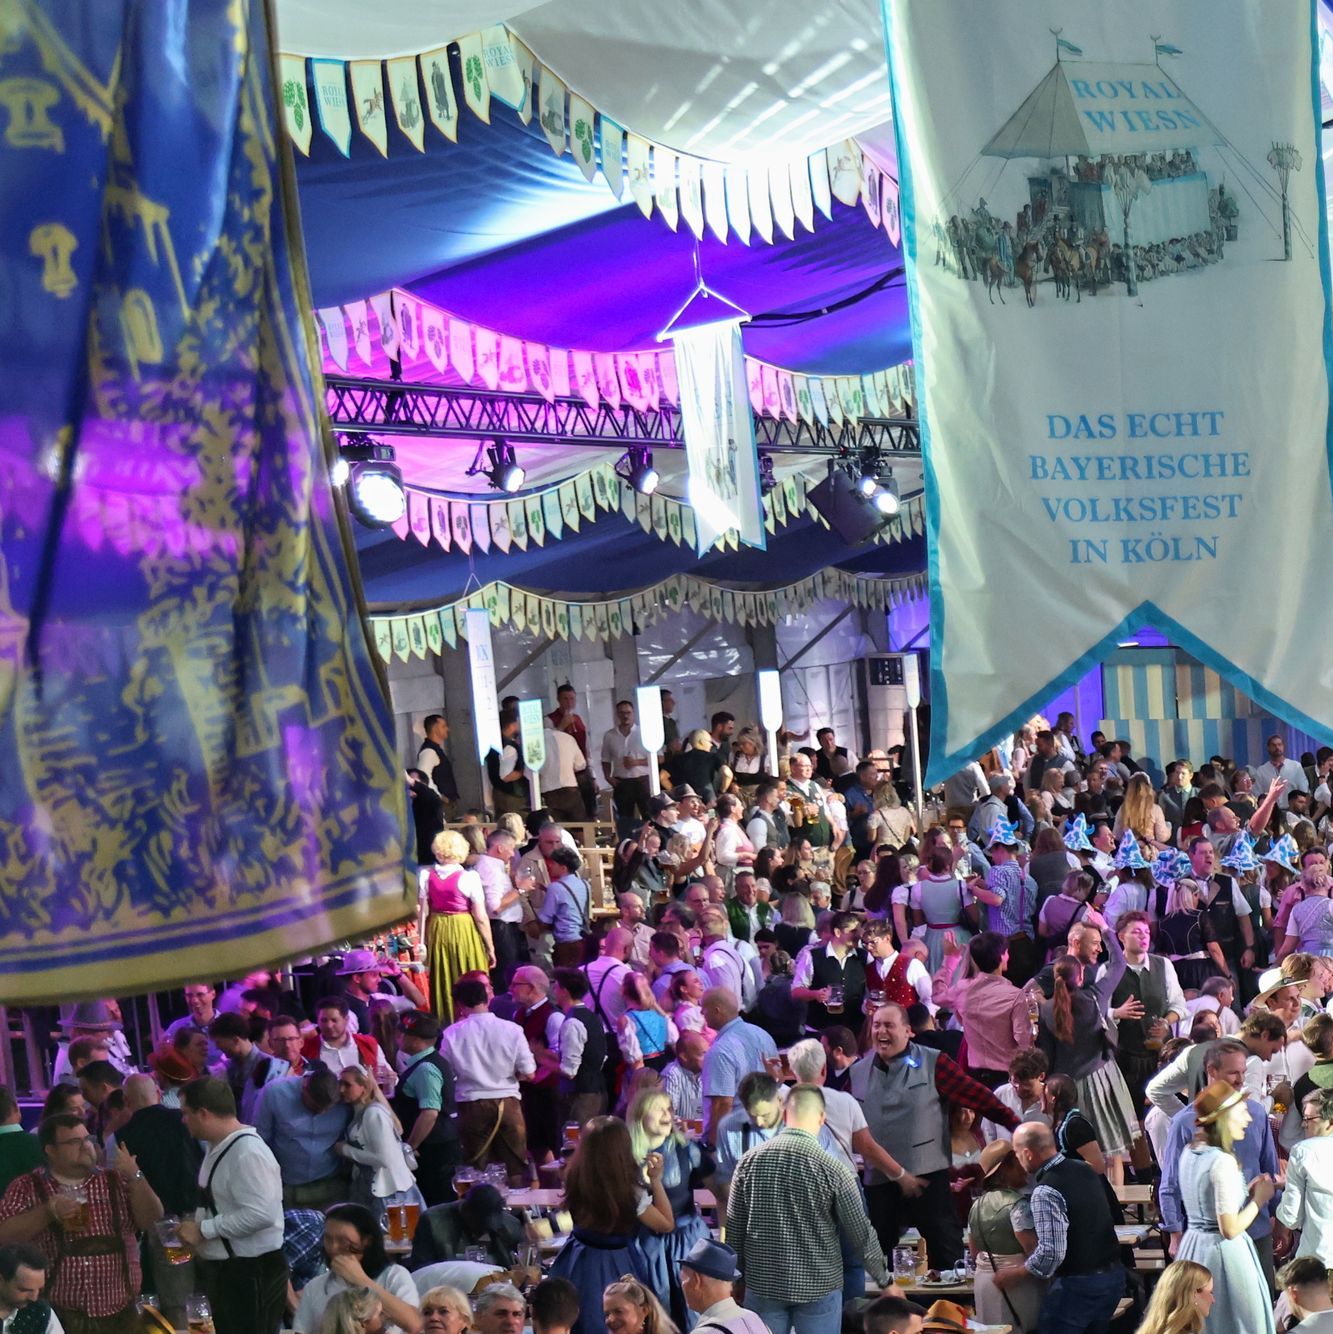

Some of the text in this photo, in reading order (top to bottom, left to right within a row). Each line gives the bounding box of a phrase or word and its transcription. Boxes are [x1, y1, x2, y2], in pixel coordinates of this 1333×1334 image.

[1071, 79, 1182, 99] ROYAL
[1083, 110, 1201, 133] WIESN
[1047, 411, 1224, 439] DAS ECHT
[1029, 452, 1251, 481] BAYERISCHE
[1041, 494, 1243, 522] VOLKSFEST
[1069, 532, 1220, 563] IN KÖLN
